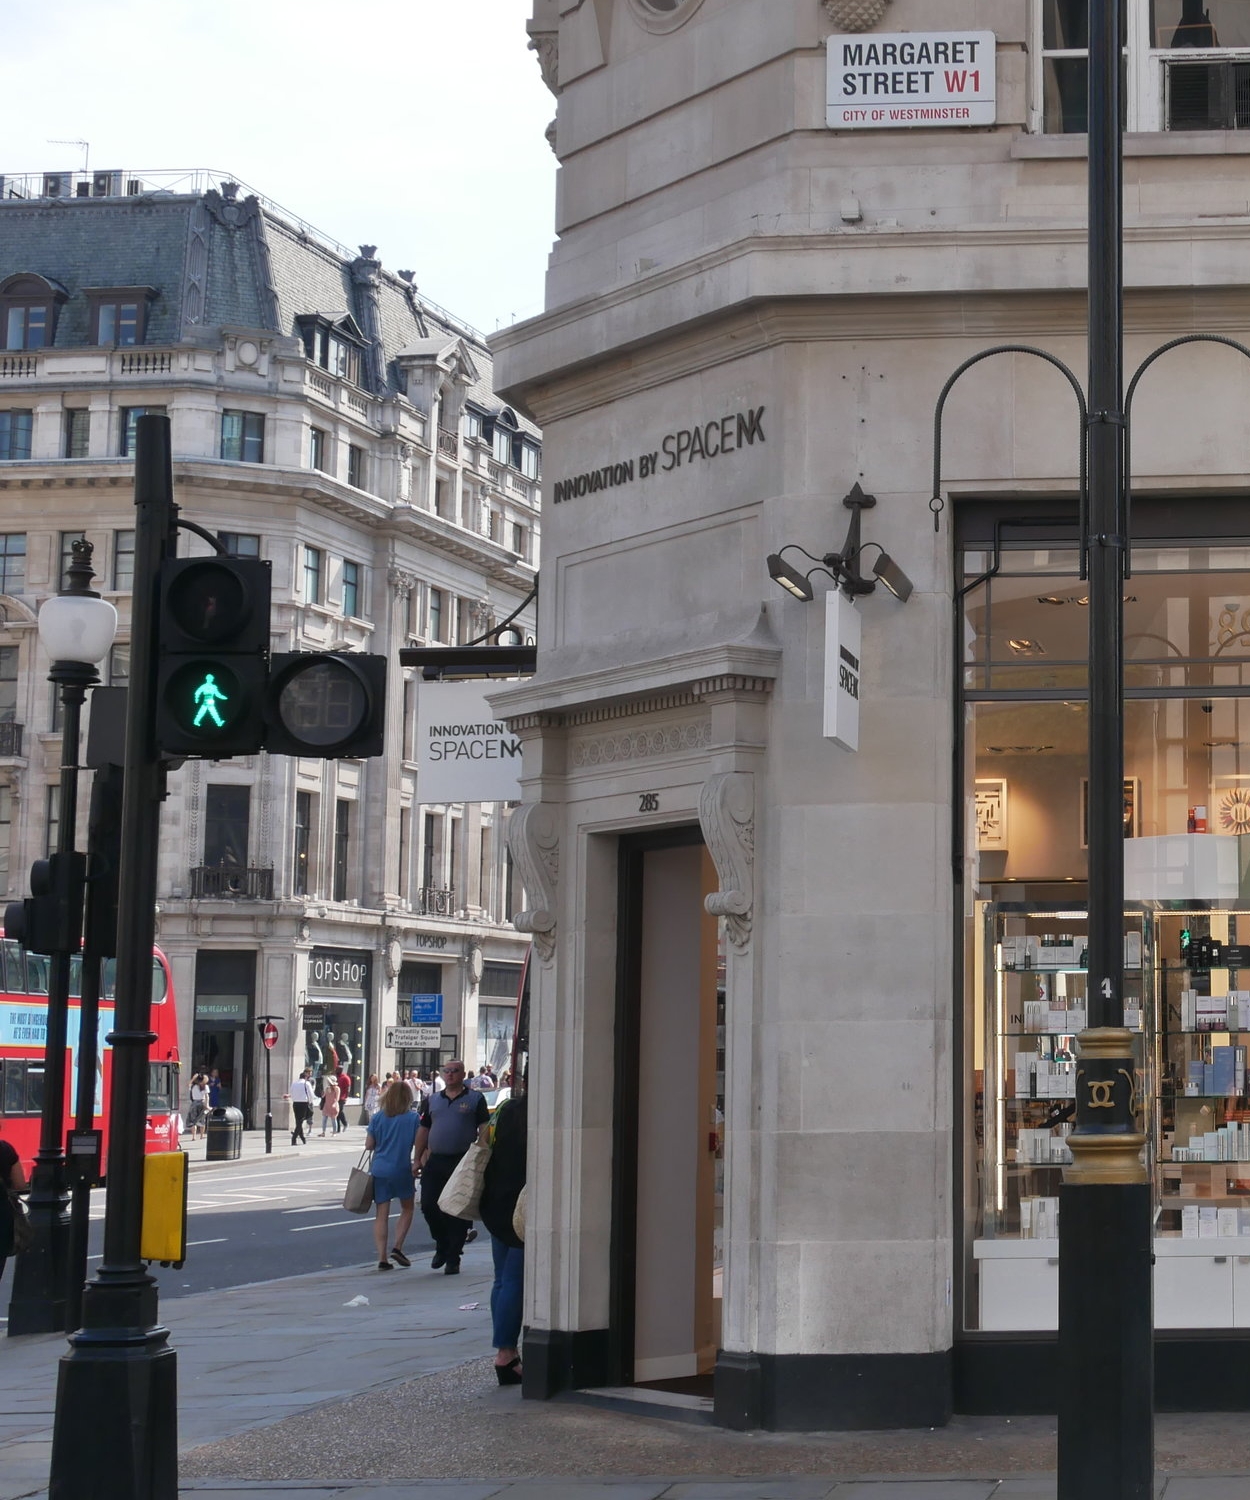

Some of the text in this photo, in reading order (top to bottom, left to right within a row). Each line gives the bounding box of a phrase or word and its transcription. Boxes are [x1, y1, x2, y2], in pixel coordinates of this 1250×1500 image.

[843, 40, 980, 66] MARGARET
[842, 70, 980, 96] STREET W1
[843, 107, 970, 122] CITY OF WESTMINSTER
[553, 405, 766, 504] INNOVATION BY SPACENK
[429, 723, 504, 737] INNOVATION
[638, 792, 660, 812] 285
[415, 933, 448, 949] TOPSHOP
[308, 960, 367, 983] TOPSHOP
[1101, 977, 1112, 998] 4
